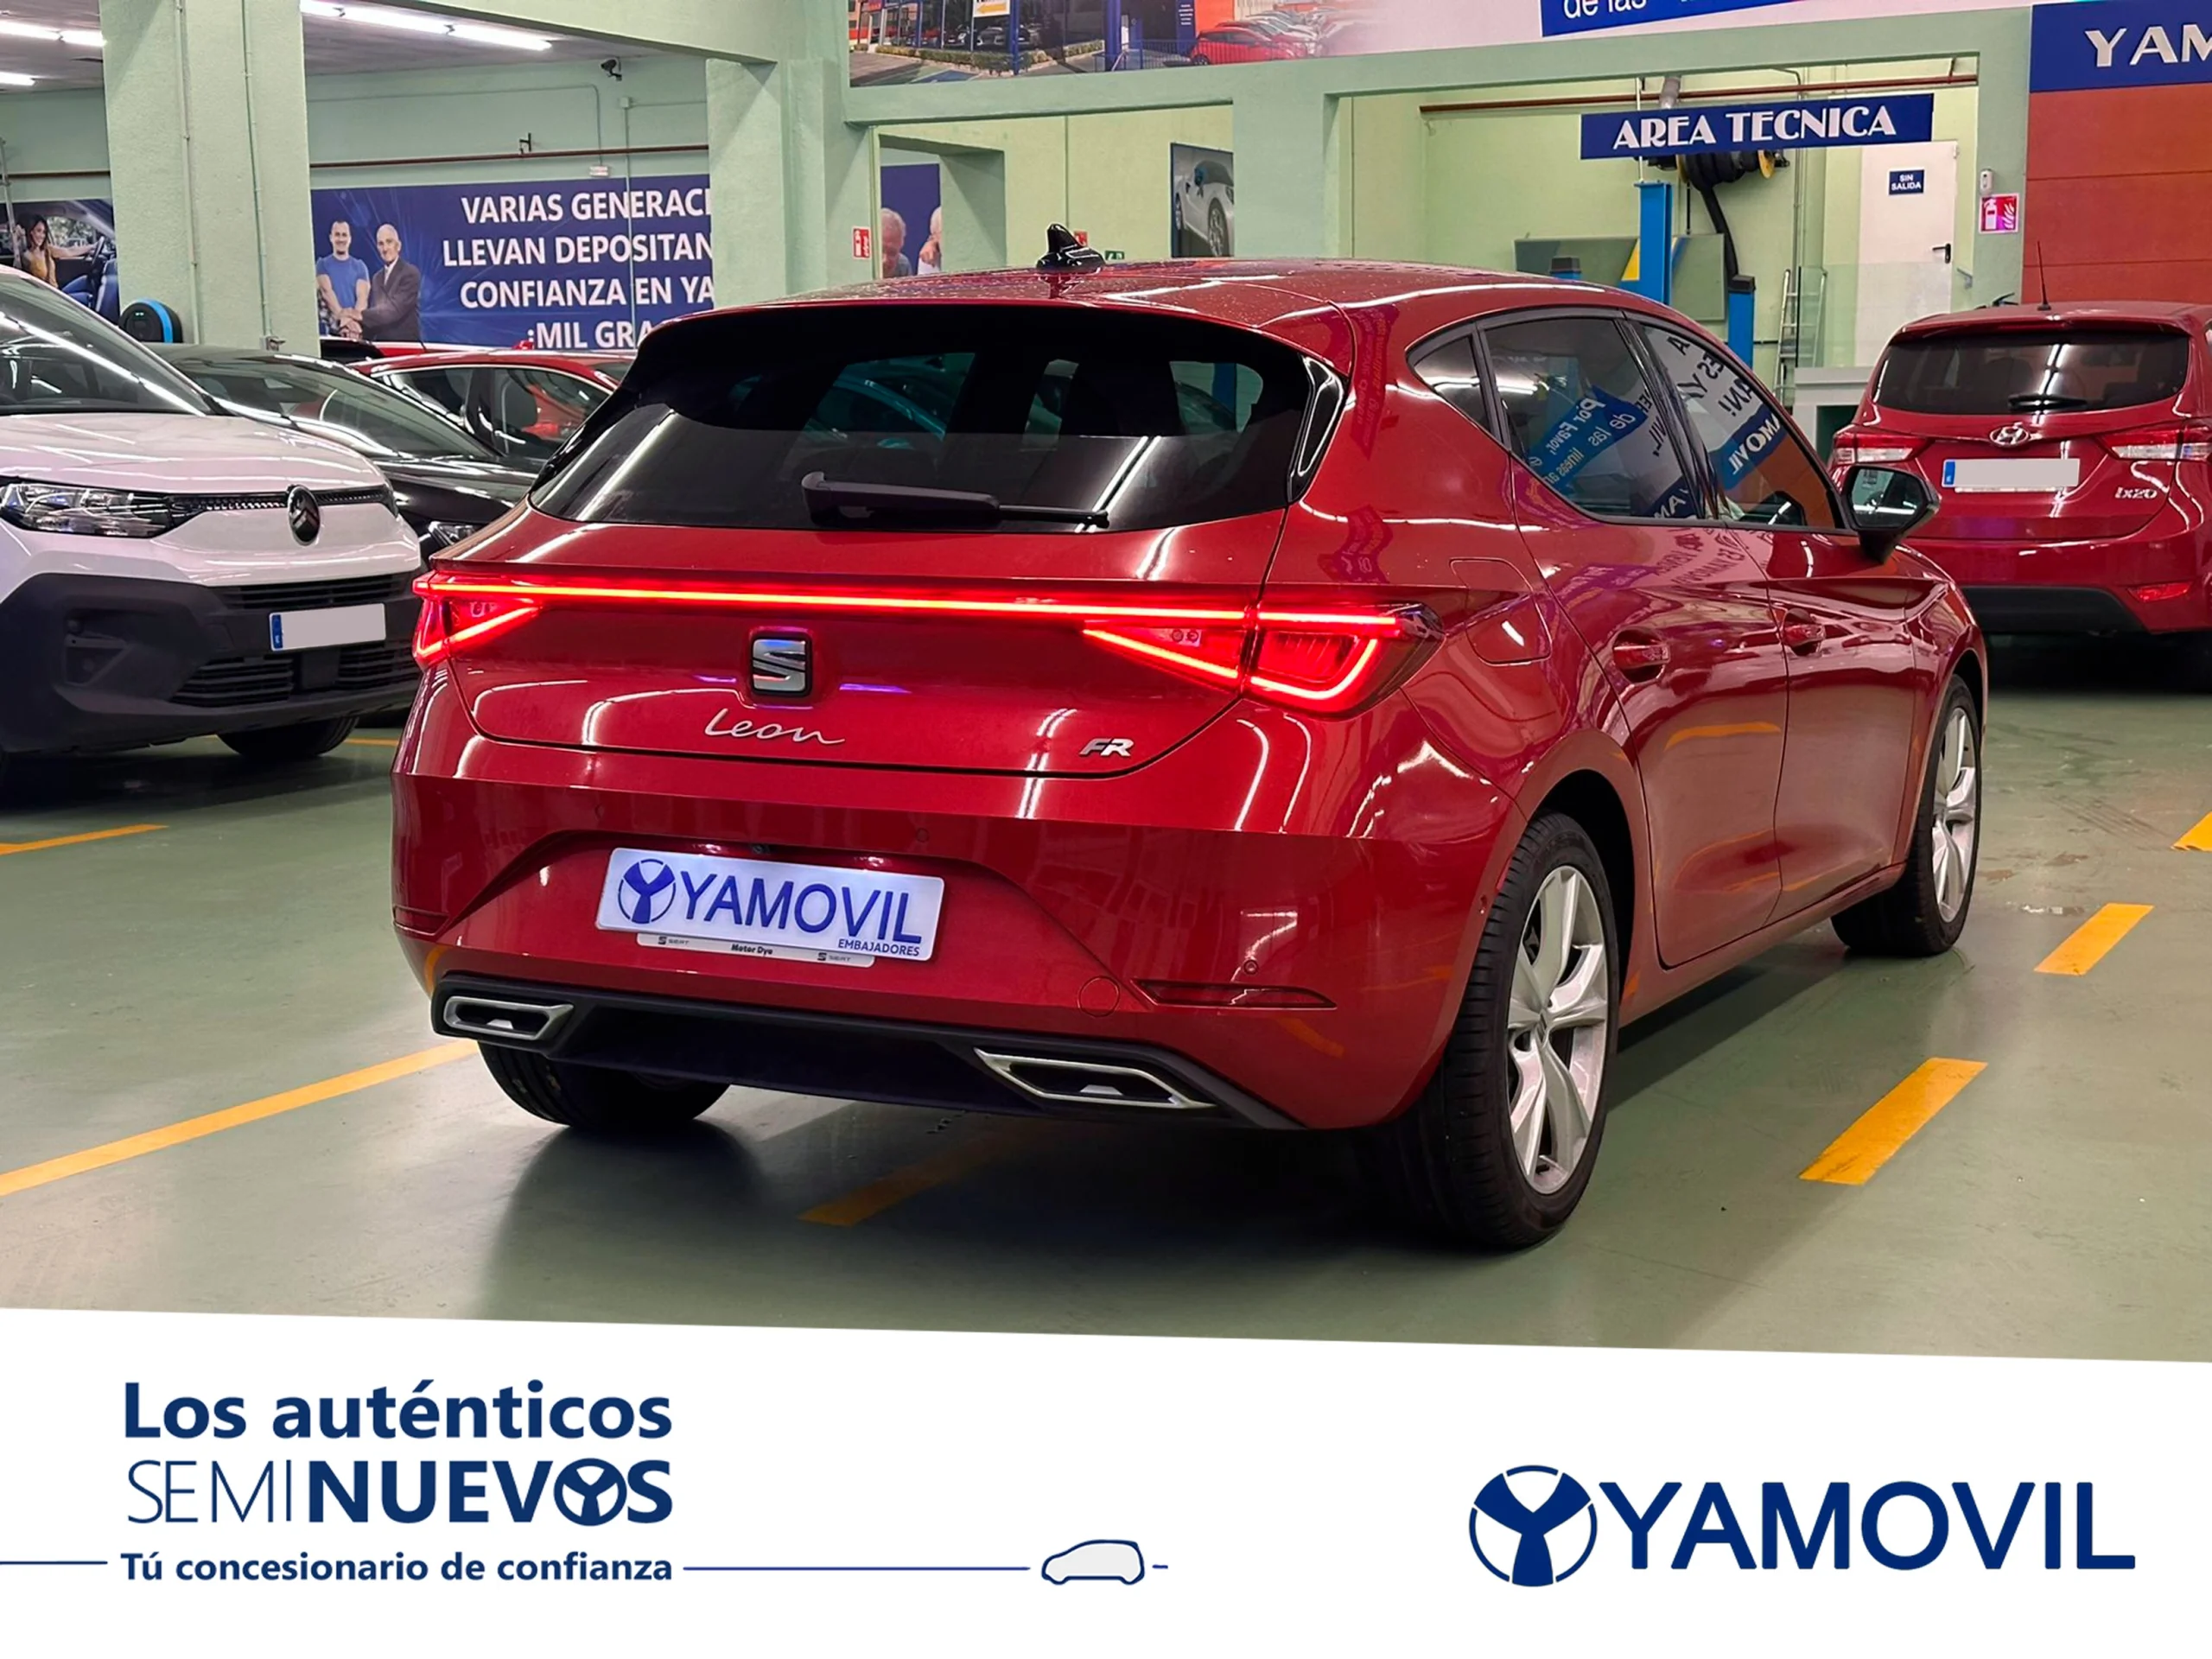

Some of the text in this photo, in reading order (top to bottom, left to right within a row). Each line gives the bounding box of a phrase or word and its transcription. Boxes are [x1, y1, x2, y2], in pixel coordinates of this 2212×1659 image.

[2084, 24, 2212, 67] YAM
[1612, 105, 1897, 149] AREA TECNICA
[1891, 181, 1922, 191] SALIDA
[1899, 174, 1914, 182] SIN
[461, 194, 563, 225] VARIAS
[442, 232, 714, 267] LLEVAN DEPOSITAN
[460, 275, 715, 309] CONFIANZA EN YA
[704, 707, 847, 746] Leon
[1079, 737, 1135, 758] FR
[680, 869, 923, 944] YAMOVIL
[837, 938, 921, 957] EMBAJADORES
